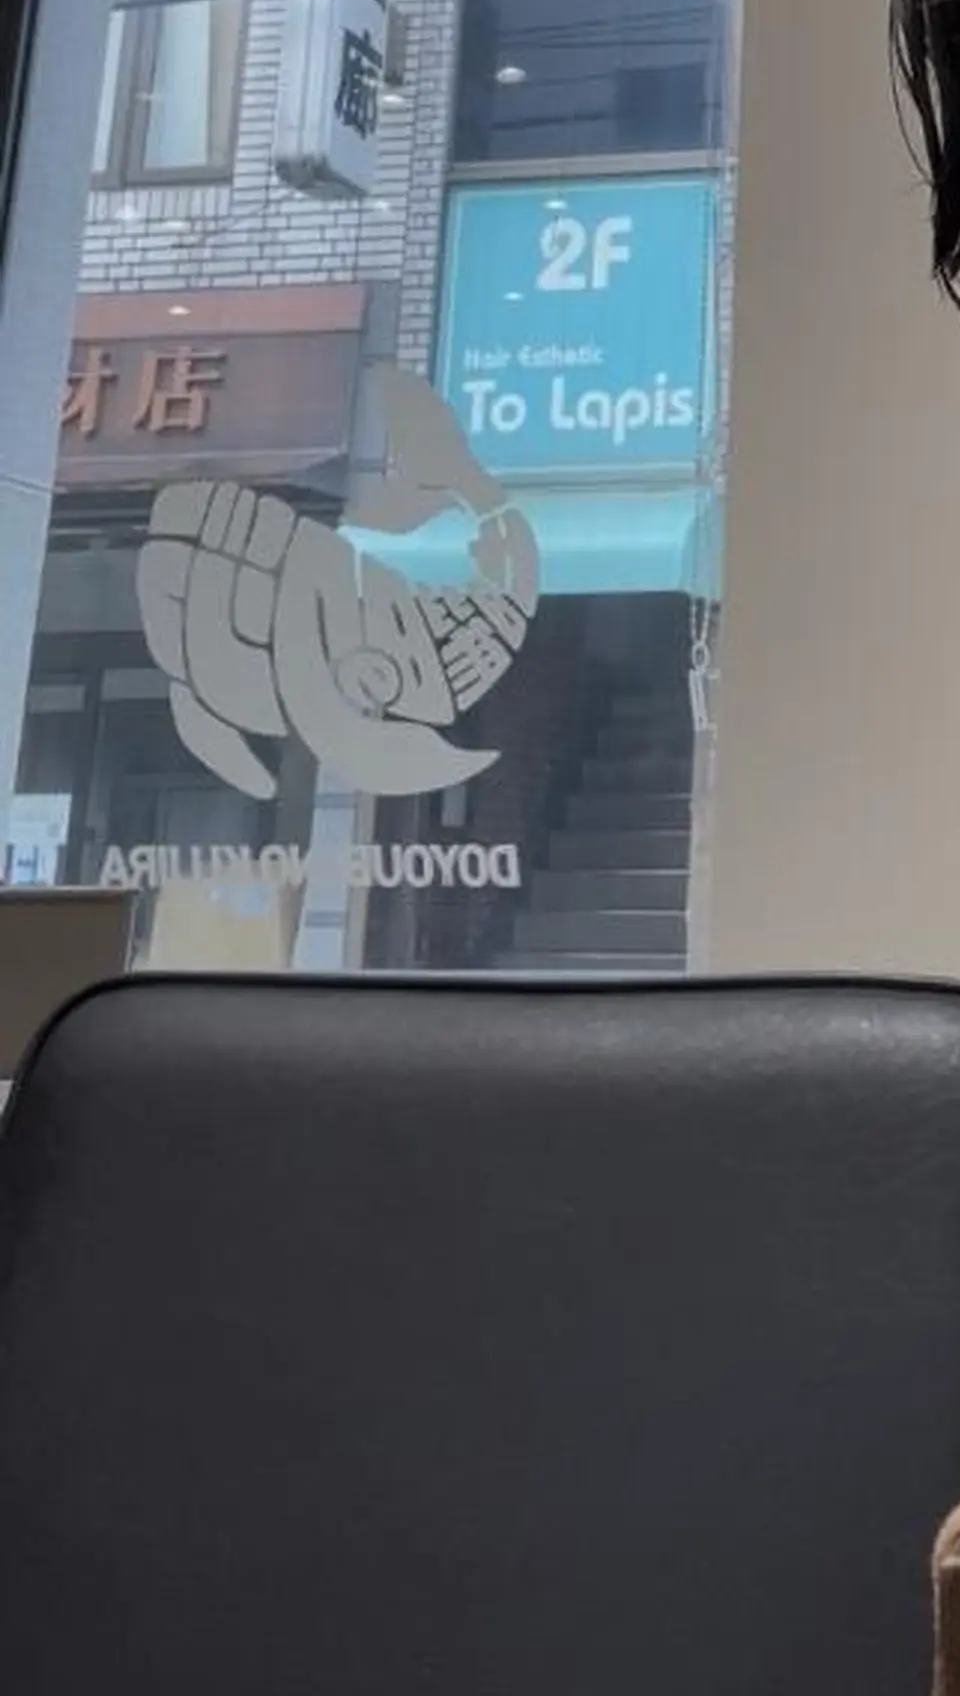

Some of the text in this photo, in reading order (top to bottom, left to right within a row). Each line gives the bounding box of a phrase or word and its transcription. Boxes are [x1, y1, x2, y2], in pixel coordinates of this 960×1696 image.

[536, 215, 632, 291] 2F
[462, 371, 695, 446] To Lapis
